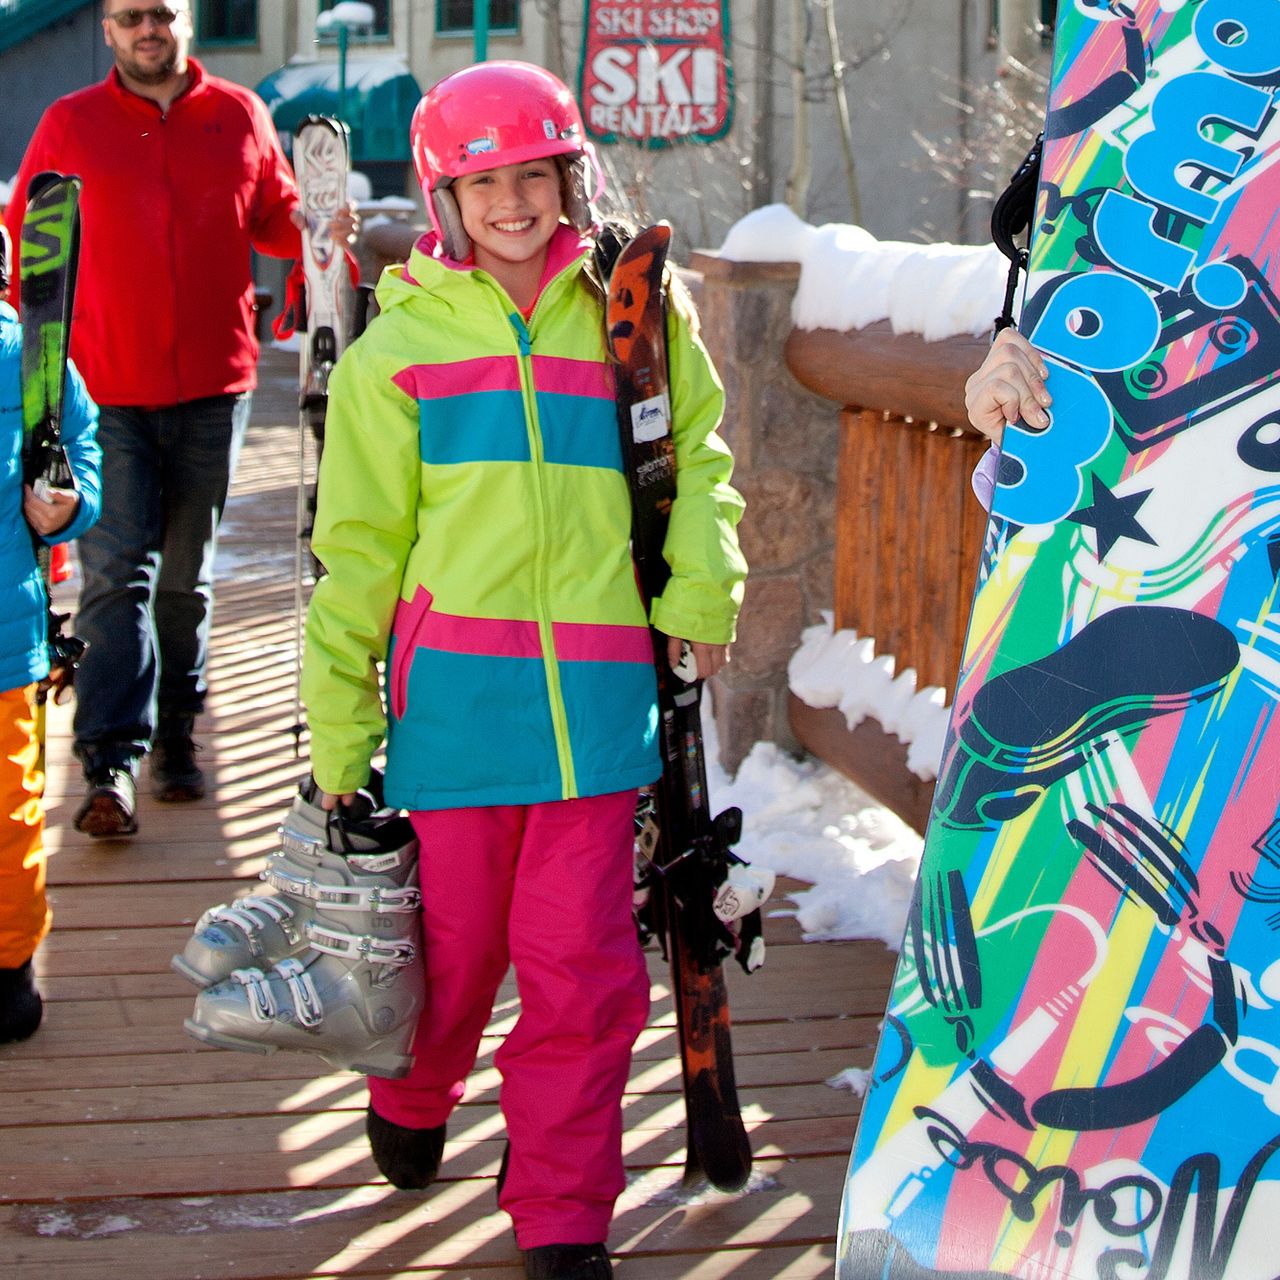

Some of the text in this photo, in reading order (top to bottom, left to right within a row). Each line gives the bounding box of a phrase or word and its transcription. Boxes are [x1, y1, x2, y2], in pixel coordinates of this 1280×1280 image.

[595, 7, 720, 36] SKI SHOP
[591, 47, 718, 106] SKI
[590, 104, 718, 137] RENTALS
